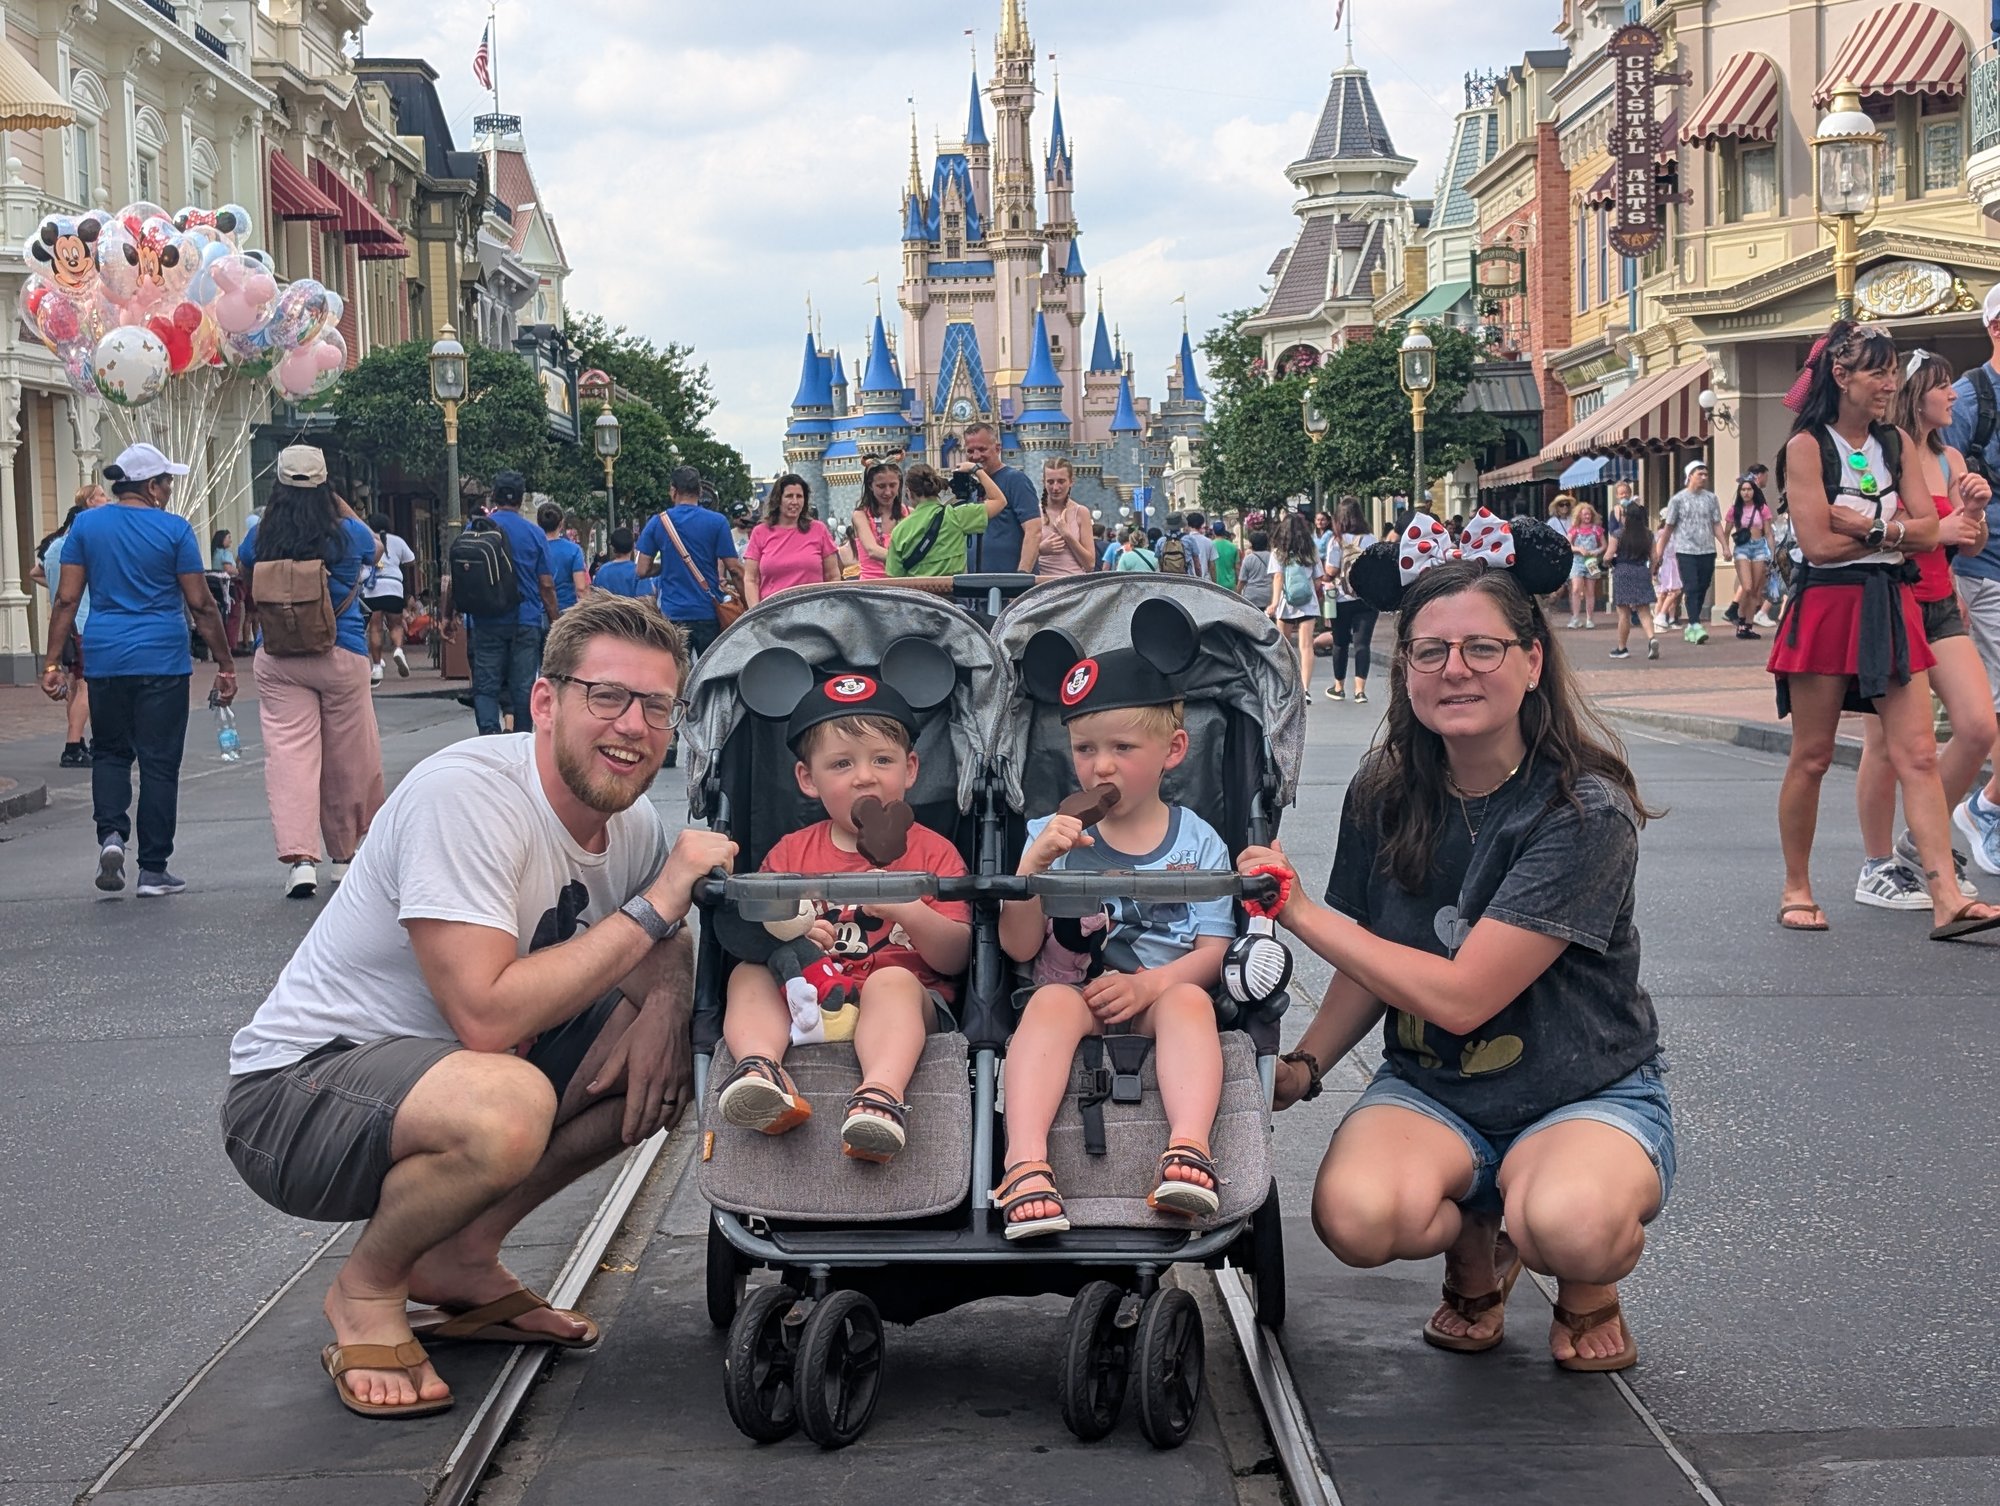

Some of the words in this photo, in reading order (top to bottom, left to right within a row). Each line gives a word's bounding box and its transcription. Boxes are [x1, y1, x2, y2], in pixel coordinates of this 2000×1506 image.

[1625, 56, 1647, 154] CRYSTAL
[1625, 169, 1647, 224] ARTS
[1482, 286, 1517, 298] COFFEE
[1578, 358, 1608, 382] BAKERY
[1166, 850, 1197, 865] OH
